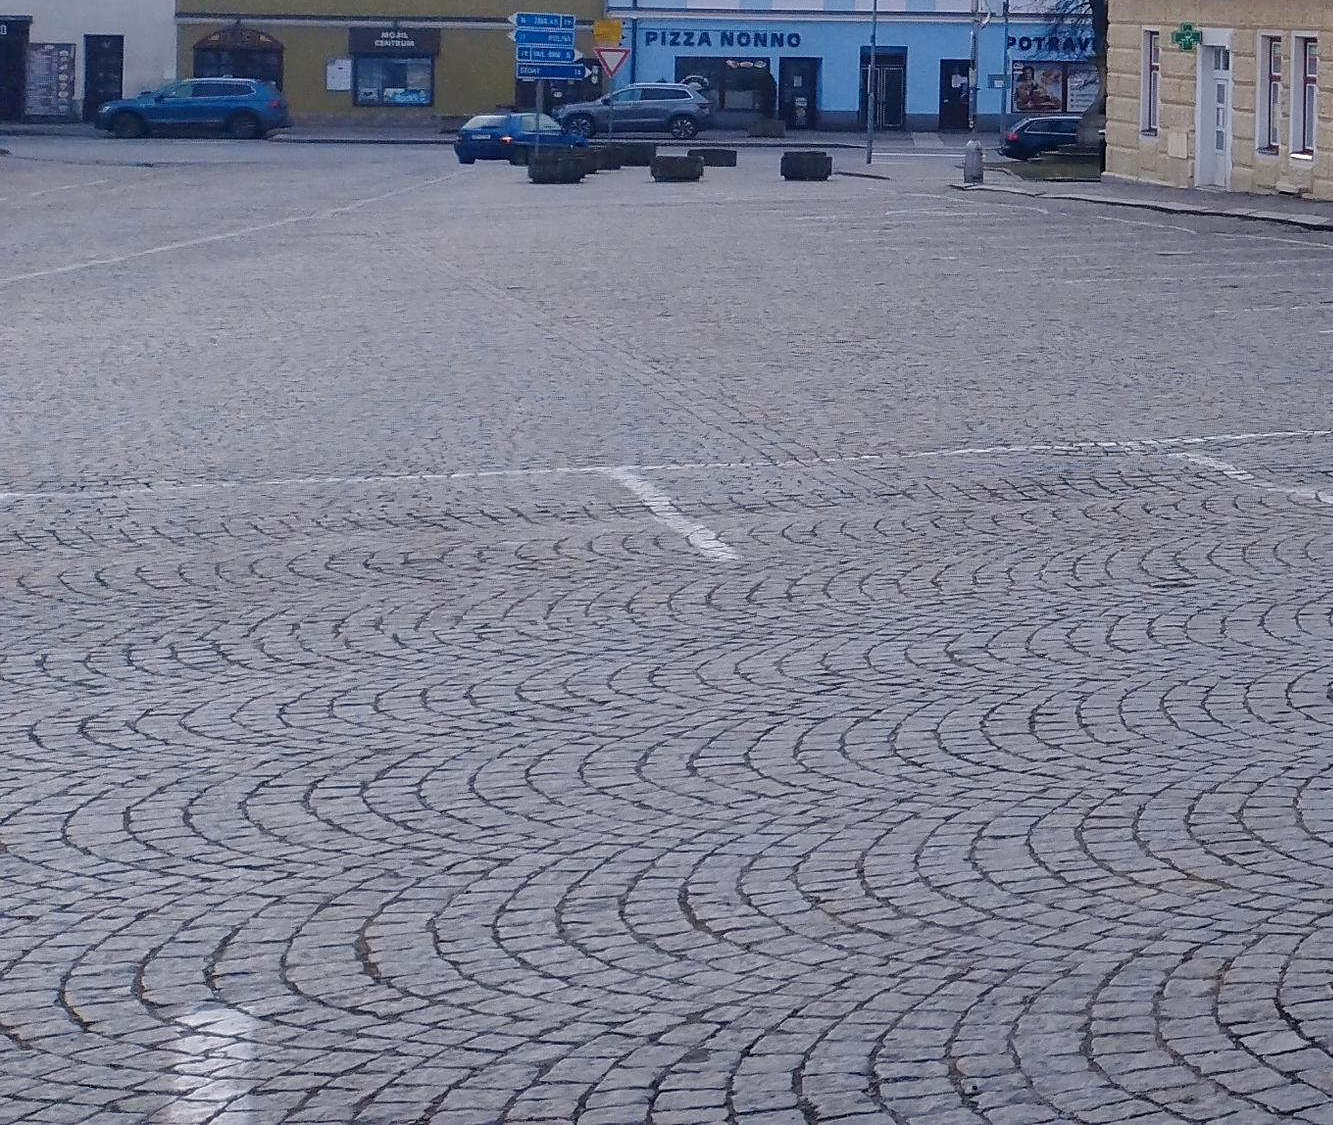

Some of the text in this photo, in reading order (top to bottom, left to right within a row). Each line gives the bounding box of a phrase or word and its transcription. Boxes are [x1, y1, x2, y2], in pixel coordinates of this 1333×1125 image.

[374, 39, 415, 47] CENTRUM
[645, 31, 801, 47] PIZZA NONNO
